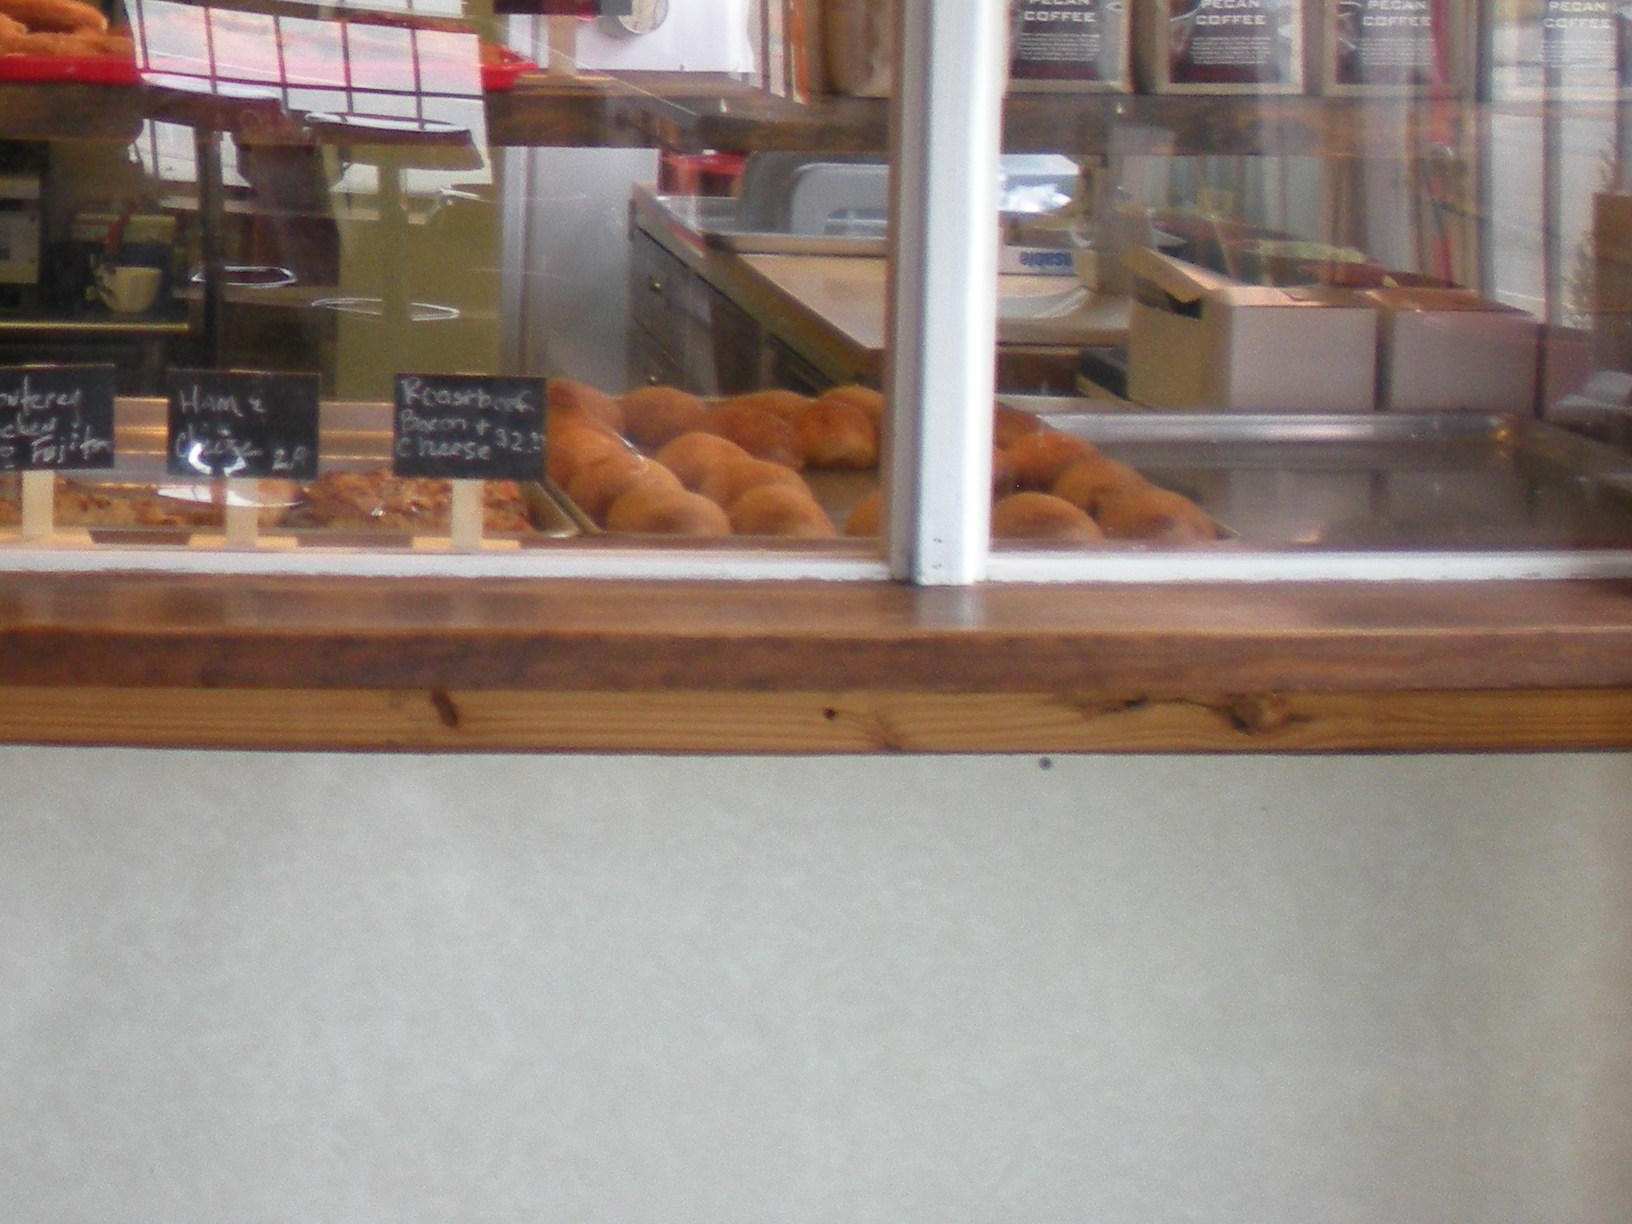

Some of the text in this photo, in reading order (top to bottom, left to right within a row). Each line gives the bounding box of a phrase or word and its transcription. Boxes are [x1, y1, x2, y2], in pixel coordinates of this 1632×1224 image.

[1367, 0, 1428, 11] PECAN
[1548, 1, 1608, 12] PECAN
[1023, 10, 1097, 23] COFFEE
[1195, 14, 1267, 26] COFFEE
[1362, 16, 1432, 27] COFFEE
[1543, 17, 1612, 29] COFFEE
[397, 436, 491, 460] Cheese
